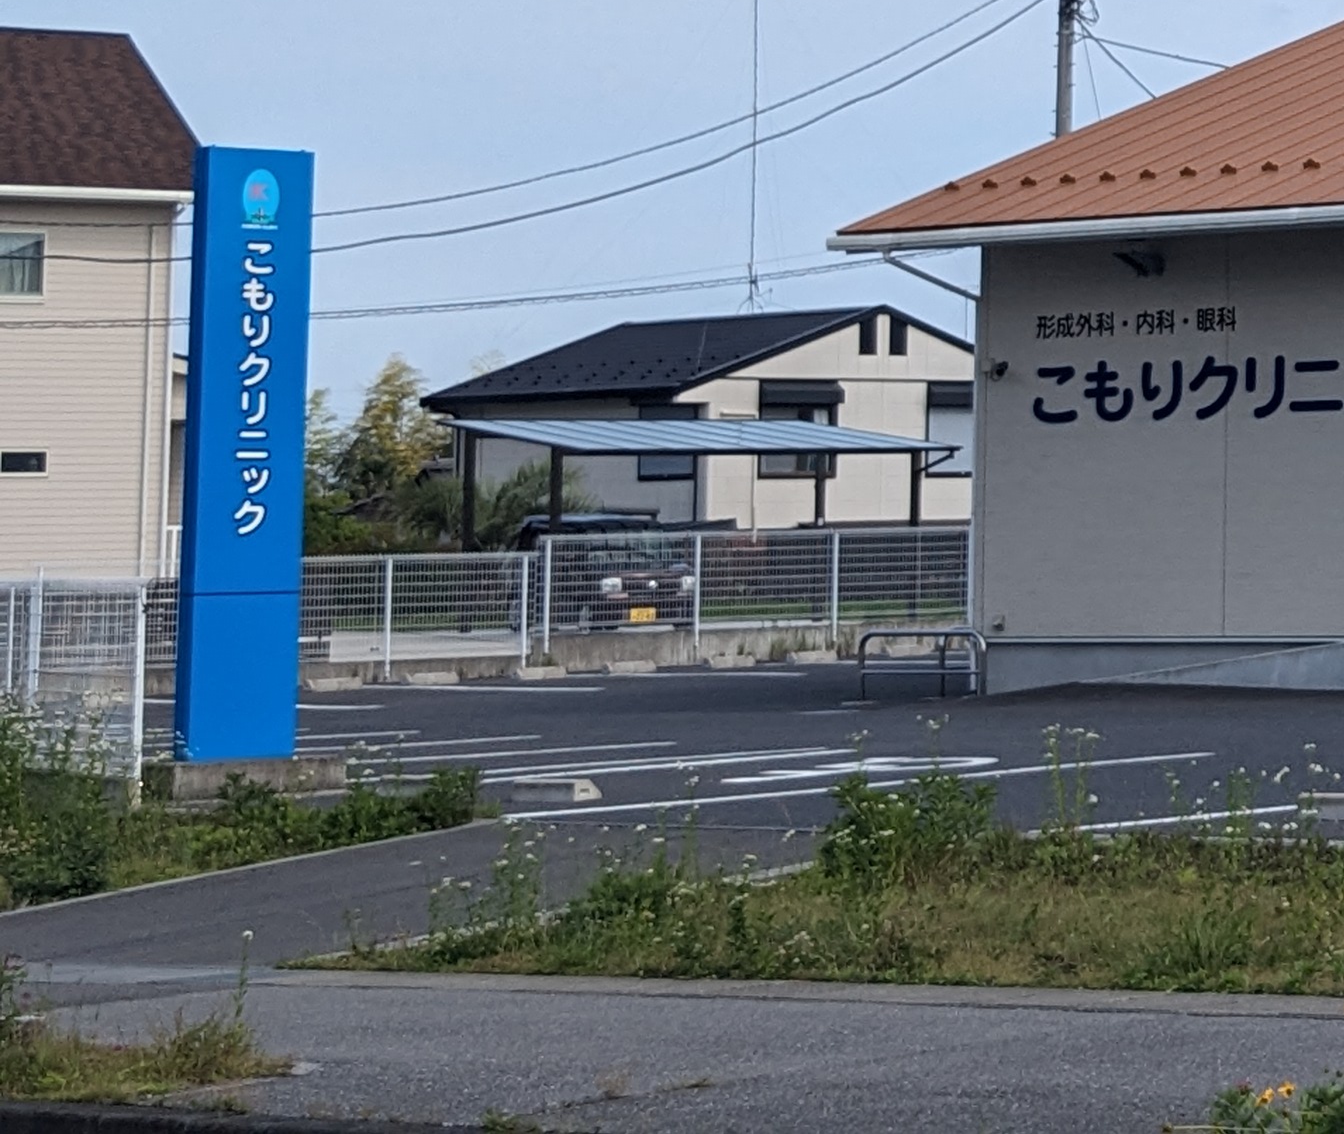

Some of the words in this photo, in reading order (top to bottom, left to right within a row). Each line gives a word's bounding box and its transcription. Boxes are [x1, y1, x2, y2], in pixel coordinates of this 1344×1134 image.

[234, 241, 274, 535] こもりクリニック
[1036, 305, 1237, 339] 形成外科・内科・眼科
